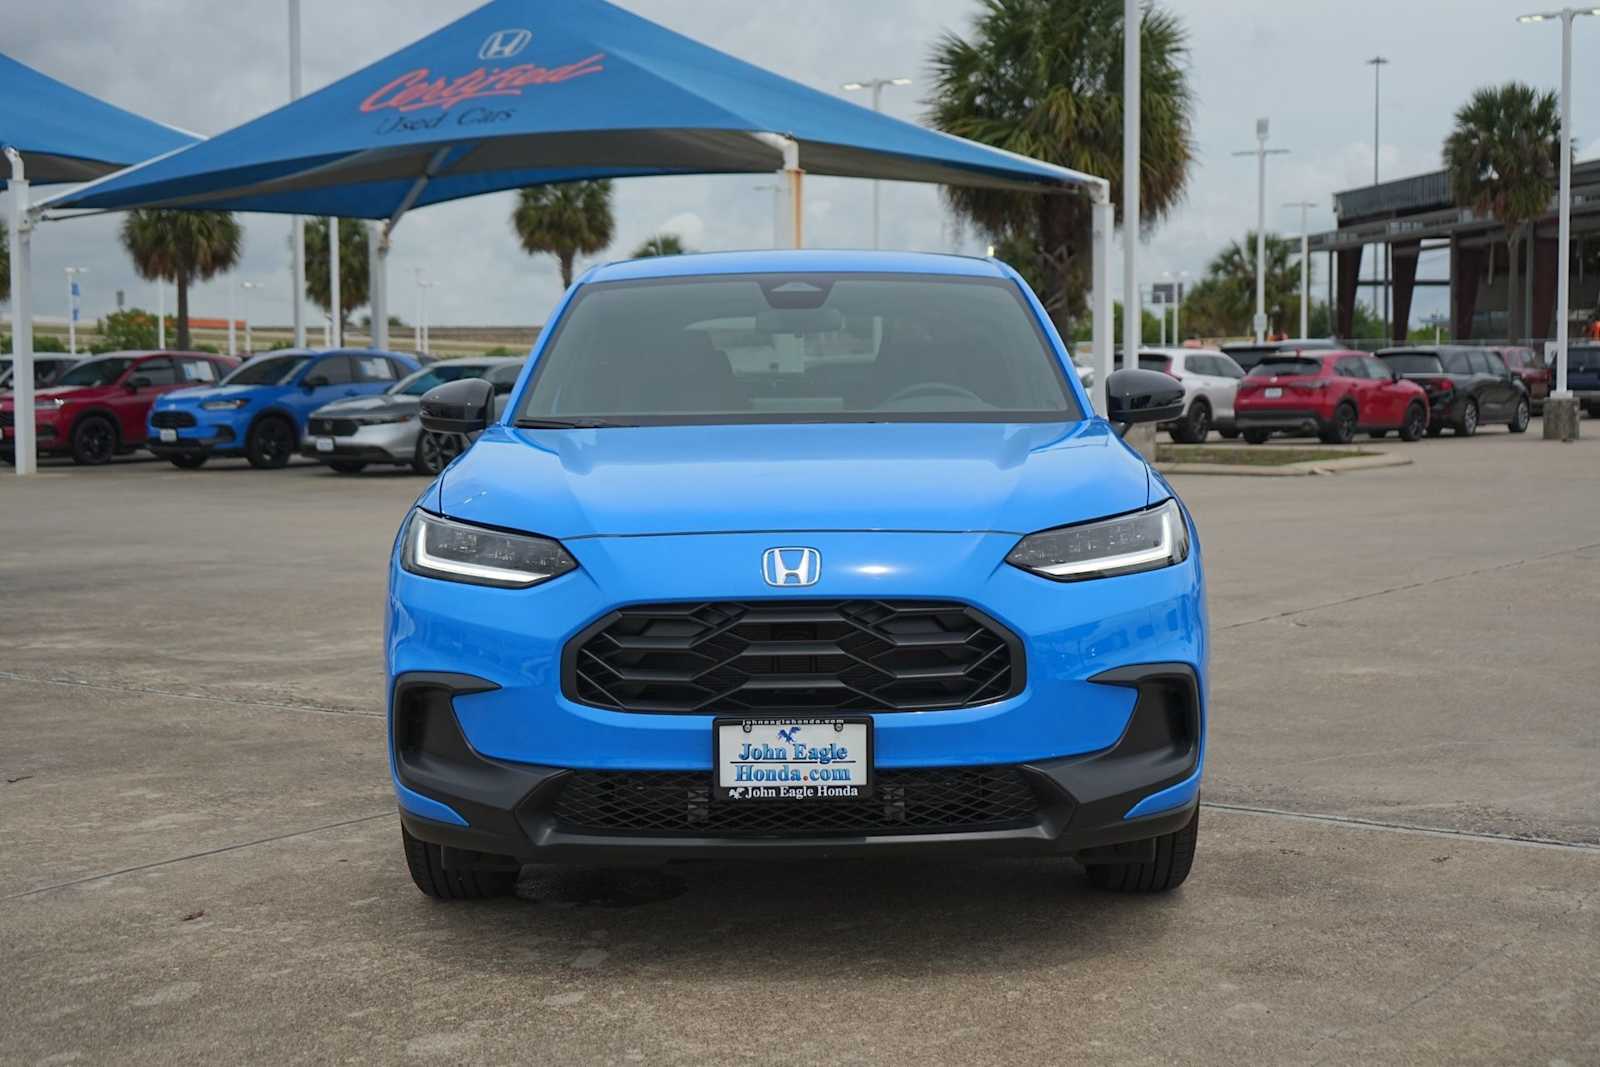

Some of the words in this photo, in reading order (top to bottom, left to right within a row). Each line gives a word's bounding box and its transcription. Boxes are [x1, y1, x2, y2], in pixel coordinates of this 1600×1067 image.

[360, 53, 605, 112] Certified
[375, 111, 448, 135] Used
[456, 106, 517, 126] Cars
[738, 743, 787, 760] John
[792, 742, 848, 764] Eagle
[734, 764, 851, 782] Honda.com
[745, 786, 776, 799] John
[780, 786, 814, 799] Eagle
[817, 785, 858, 797] Honda
